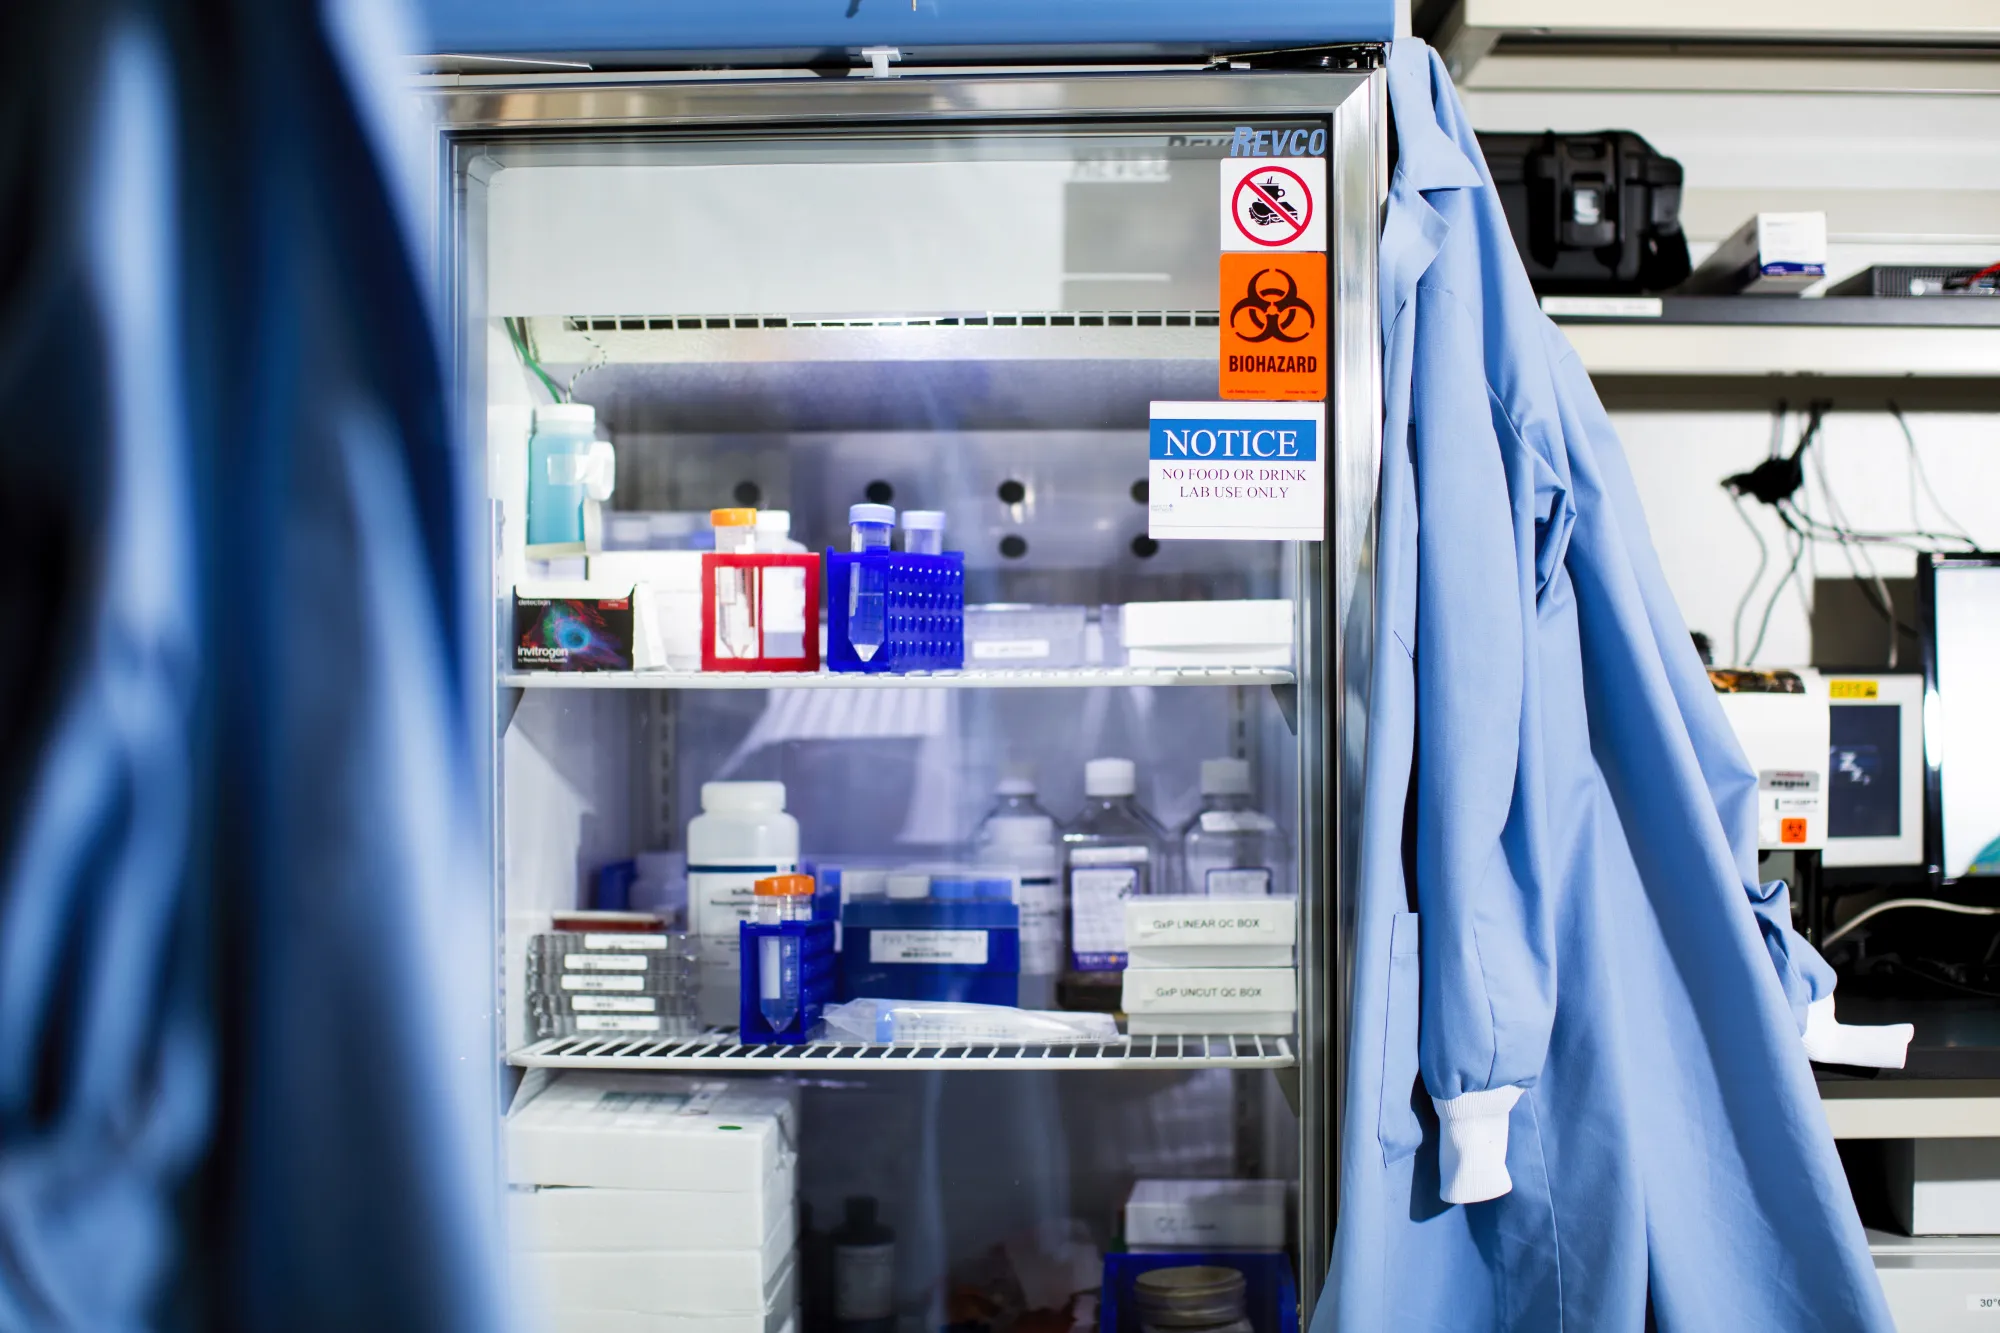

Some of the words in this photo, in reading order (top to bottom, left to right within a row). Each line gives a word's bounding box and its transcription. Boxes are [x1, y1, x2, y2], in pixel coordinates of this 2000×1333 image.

[1230, 126, 1327, 157] REVCO
[1228, 355, 1317, 373] BIOHAZARD
[1163, 429, 1299, 457] NOTICE
[1162, 468, 1184, 480] NO
[1188, 468, 1230, 480] FOOD
[1234, 468, 1255, 481] OR
[1259, 469, 1306, 481] DRINK
[1180, 486, 1210, 498] LAB
[1214, 486, 1242, 498] USE
[1247, 487, 1289, 499] ONLY
[517, 645, 569, 658] invitrogen
[1153, 920, 1175, 930] GxP
[1177, 919, 1216, 929] LINEAR
[1217, 919, 1235, 929] QC
[1237, 918, 1261, 928] BOX
[1155, 987, 1178, 998] GxP
[1180, 987, 1218, 998] UNCUT
[1220, 987, 1237, 998] QC
[1239, 987, 1262, 997] BOX
